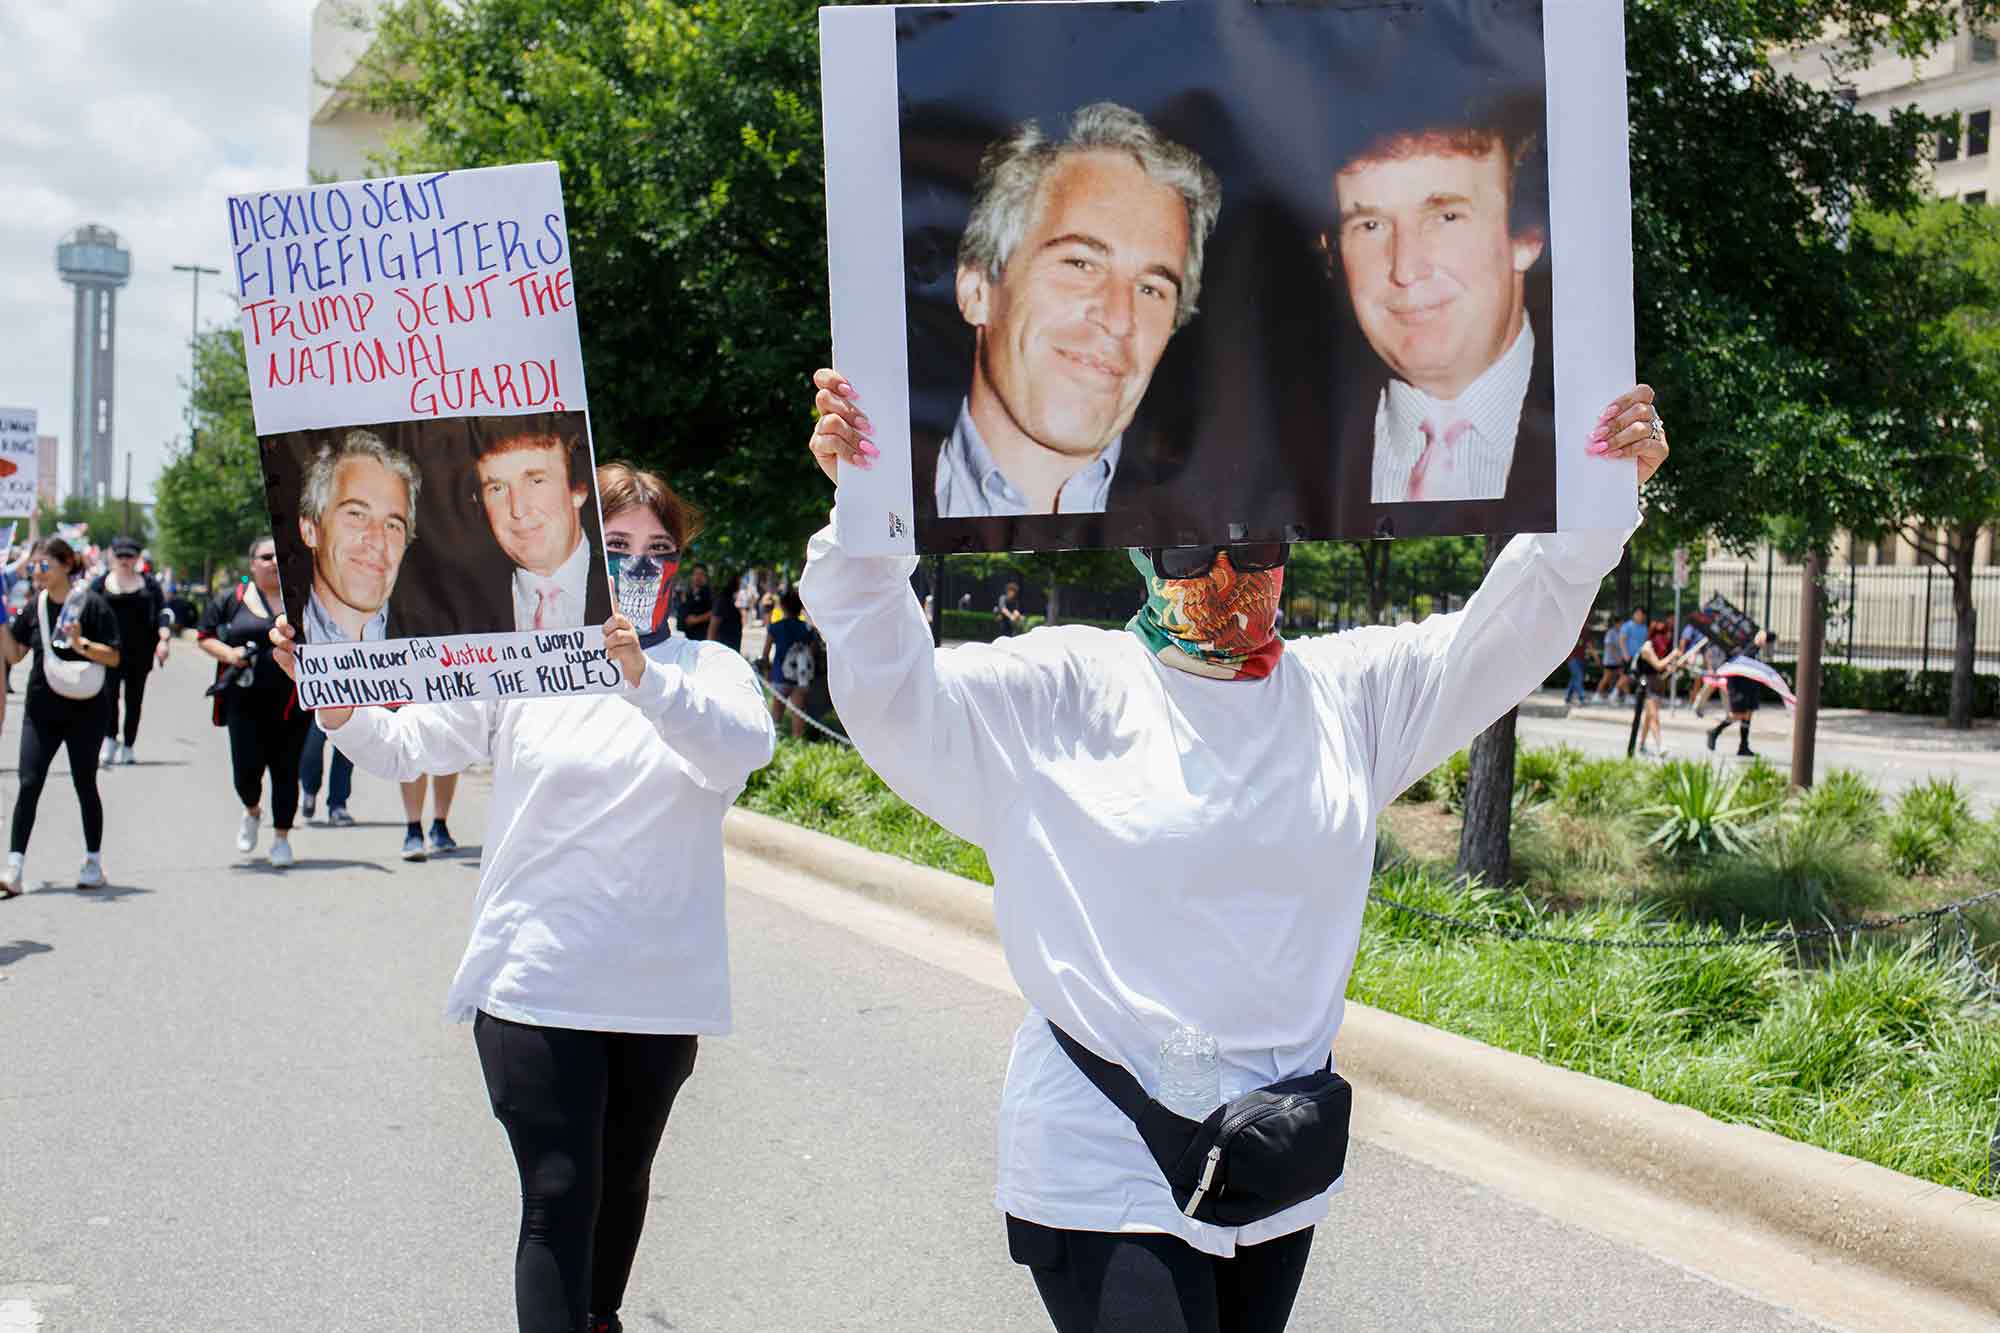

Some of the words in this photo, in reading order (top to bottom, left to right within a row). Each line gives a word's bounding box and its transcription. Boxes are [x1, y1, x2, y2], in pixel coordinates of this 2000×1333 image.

[227, 189, 352, 245] MEXICO
[362, 172, 449, 228] SENT
[236, 214, 563, 297] FIREFIGHTERS
[242, 292, 375, 344] TRUMP
[394, 273, 499, 333] SENT
[509, 267, 573, 317] THE
[268, 334, 465, 388] NATIONAL
[410, 360, 566, 416] GUARD!
[300, 678, 413, 707] CRIMINALS
[425, 671, 480, 701] MAKE
[488, 670, 528, 695] THE
[536, 658, 620, 693] RULES
[334, 648, 368, 670] will
[369, 649, 408, 670] never
[440, 643, 497, 668] Justice
[502, 646, 517, 660] in
[521, 646, 532, 658] a
